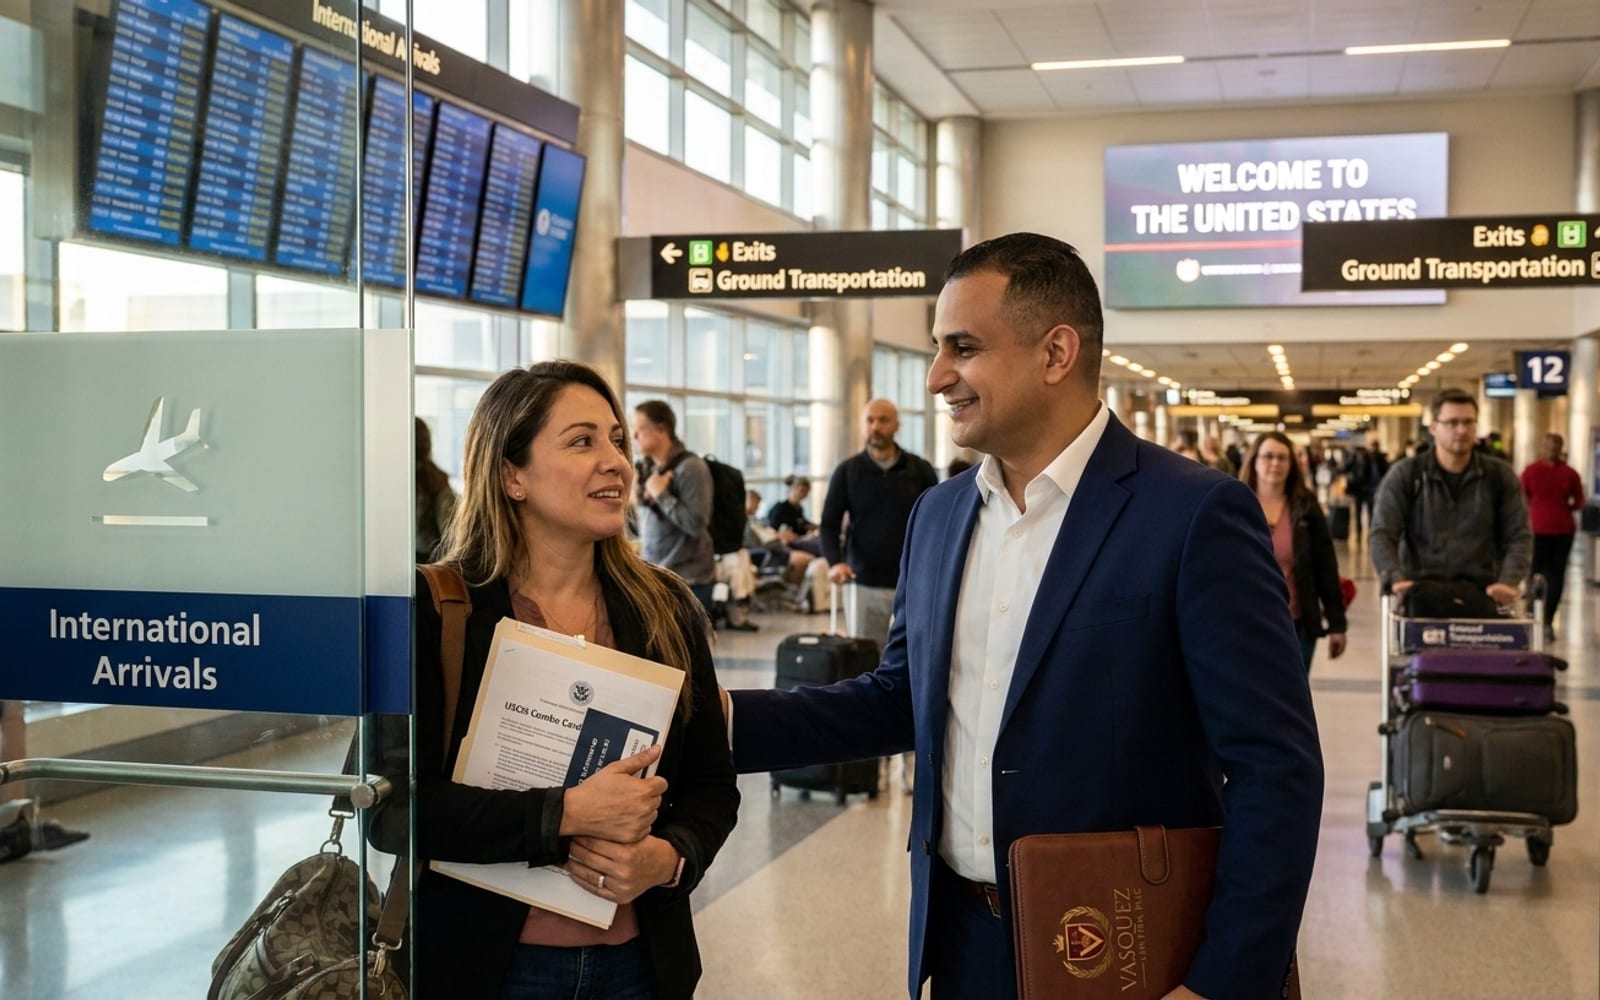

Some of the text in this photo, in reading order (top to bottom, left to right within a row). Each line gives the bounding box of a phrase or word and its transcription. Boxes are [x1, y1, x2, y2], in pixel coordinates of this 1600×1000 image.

[395, 37, 440, 75] Aivals
[1177, 158, 1369, 193] WELCOME TO
[1131, 203, 1188, 234] THE
[1194, 201, 1300, 233] UNITED
[732, 241, 776, 262] Exits
[1473, 225, 1526, 247] Exits
[716, 267, 926, 293] Ground Transportation
[1341, 255, 1586, 284] Ground Transportation
[1526, 355, 1564, 384] 12
[50, 608, 260, 647] International
[92, 655, 218, 691] Arrivals
[1114, 888, 1137, 992] VASQUEZ
